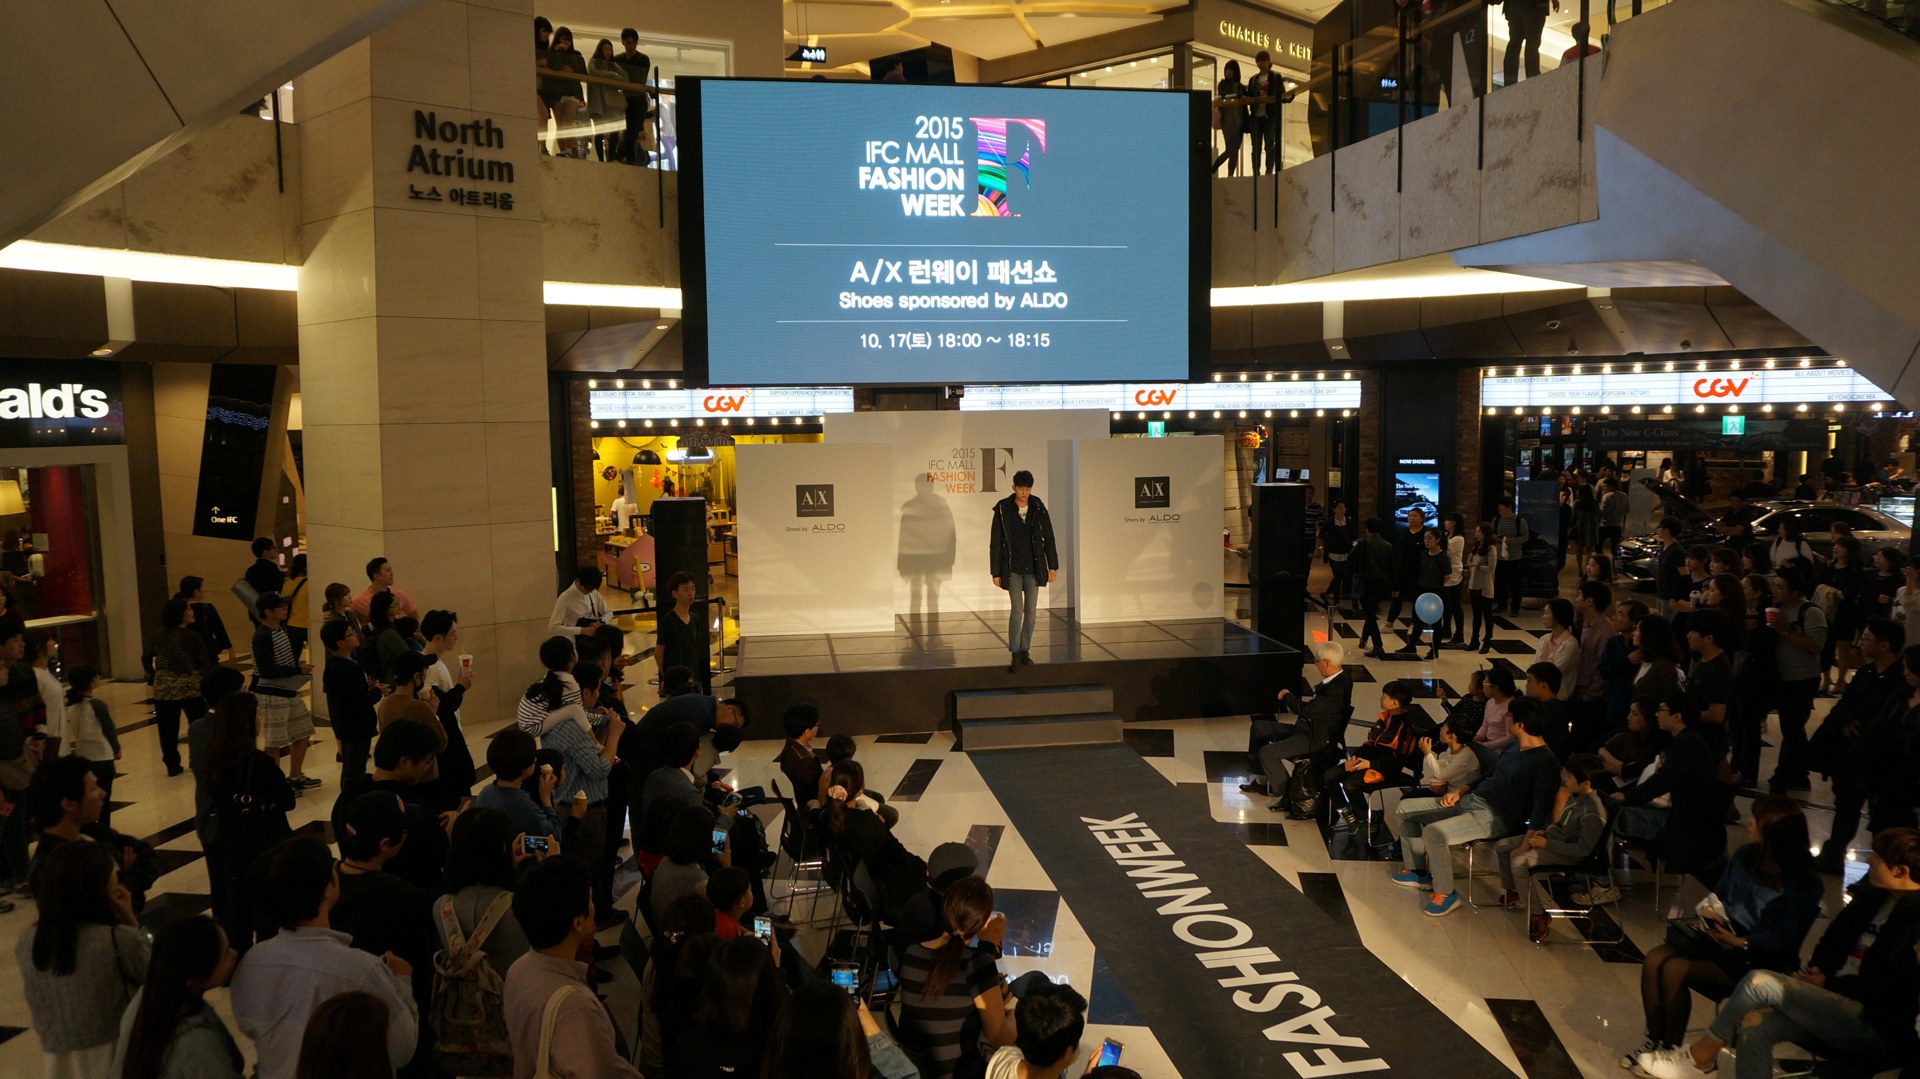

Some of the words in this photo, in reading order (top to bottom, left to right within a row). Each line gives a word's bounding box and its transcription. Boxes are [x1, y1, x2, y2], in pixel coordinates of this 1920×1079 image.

[1220, 20, 1270, 48] CHARLES
[1275, 38, 1283, 53] &
[414, 109, 504, 149] North
[915, 115, 964, 139] 2015
[866, 141, 900, 163] IFC
[905, 142, 965, 165] MALL
[407, 144, 514, 184] Atrium
[858, 166, 965, 190] FASHION
[408, 184, 443, 202] 노스
[449, 188, 515, 211] 아트리움
[901, 193, 966, 217] WEEK
[850, 258, 902, 286] A/X
[908, 259, 978, 285] 런웨이
[987, 259, 1057, 285] 패션쇼
[839, 291, 894, 309] Shoes
[898, 291, 989, 310] sponsored
[994, 291, 1015, 310] by
[1020, 292, 1068, 309] ALDO
[860, 333, 882, 349] 10.
[889, 331, 932, 350] 17(토)
[937, 332, 982, 348] 18:00
[1007, 332, 1050, 348] 18:15
[1134, 389, 1177, 407] CGV
[1693, 377, 1749, 398] CGV
[703, 395, 745, 413] CGV
[952, 447, 976, 459] 2015
[928, 459, 945, 470] IFC
[947, 459, 976, 470] MALL
[926, 471, 976, 482] FASHION
[945, 483, 976, 493] WEEK
[812, 523, 846, 531] ALDO
